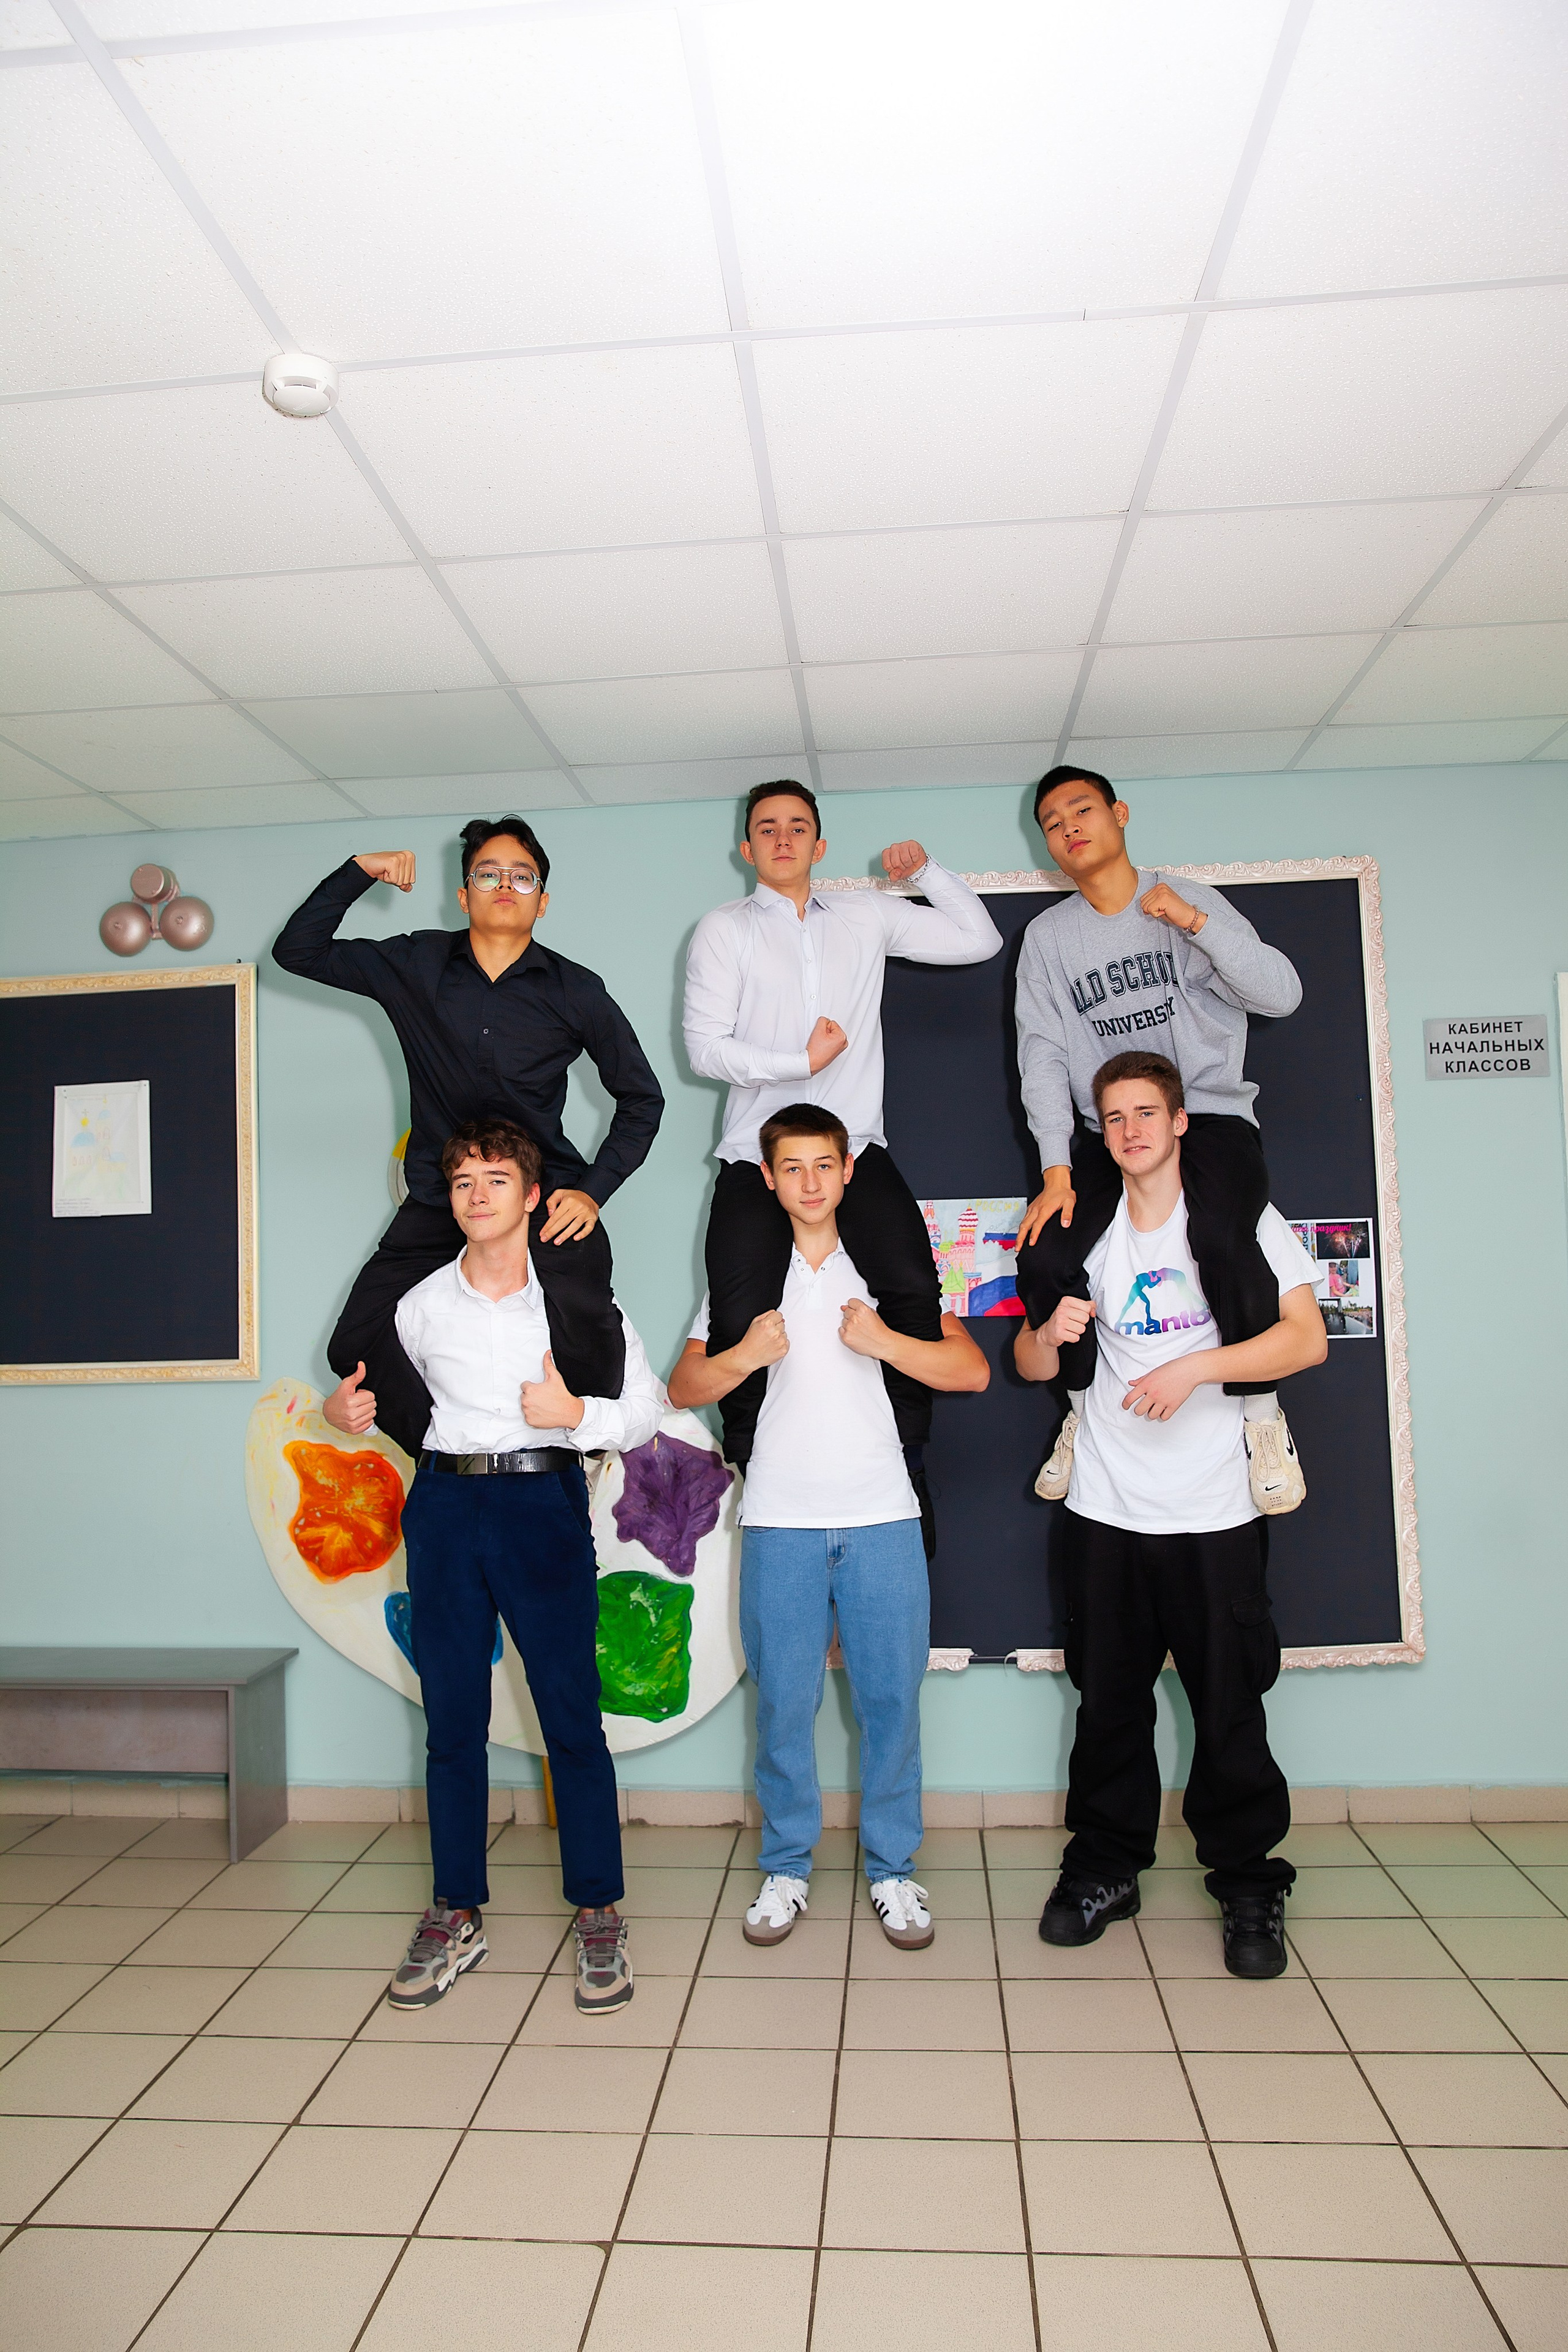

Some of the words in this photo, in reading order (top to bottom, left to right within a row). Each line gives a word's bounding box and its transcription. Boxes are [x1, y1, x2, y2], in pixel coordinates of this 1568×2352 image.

[1448, 1021, 1523, 1035] КАБИНЕТ
[1429, 1038, 1545, 1054] НАЧАЛЬНЫХ
[1445, 1058, 1531, 1072] КЛАССОВ
[975, 1199, 1019, 1213] РОССИЯ
[1311, 1223, 1352, 1234] праздник!
[1114, 1310, 1212, 1335] manto
